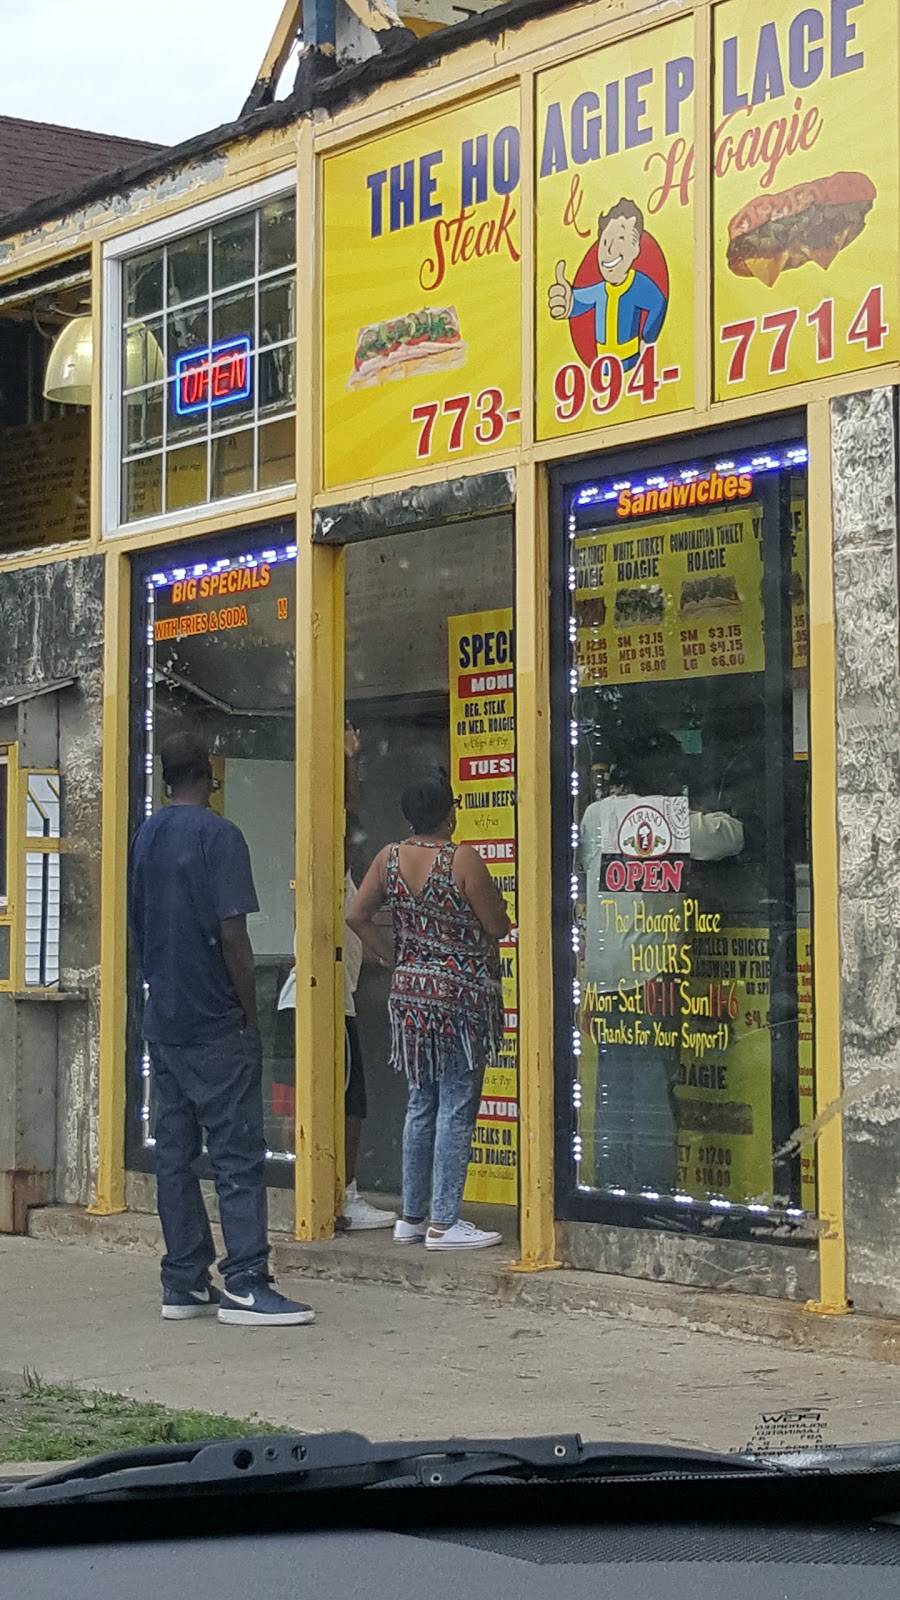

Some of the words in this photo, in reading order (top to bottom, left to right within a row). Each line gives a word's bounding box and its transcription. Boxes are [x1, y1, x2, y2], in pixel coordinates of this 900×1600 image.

[366, 149, 443, 239] THE
[461, 67, 654, 207] HOAGIE
[664, 0, 865, 136] PLACE
[419, 194, 521, 291] Steak
[562, 173, 592, 239] &
[643, 97, 824, 214] Hoagie
[182, 352, 247, 404] OPEN
[410, 387, 521, 459] 773-
[553, 344, 680, 422] 994-
[719, 285, 888, 385] 7714
[616, 472, 753, 518] Sandwiches
[637, 535, 664, 558] TURKEY
[670, 527, 714, 552] COMBINATION
[716, 522, 744, 546] TURKEY
[618, 558, 660, 582] HOAGIE
[687, 548, 726, 573] HOAGIE
[171, 580, 197, 604] BIG
[200, 563, 271, 598] SPECIALS
[155, 618, 178, 640] WITH
[180, 613, 208, 635] FRIES
[209, 611, 217, 632] &
[219, 605, 248, 629] SODA
[680, 629, 699, 643] SM
[708, 625, 742, 639] $3.15
[617, 635, 632, 648] SM
[639, 632, 663, 645] $3.15
[682, 643, 706, 657] MED
[709, 639, 743, 653] $4.15
[619, 649, 637, 661] MED
[639, 645, 665, 659] $4.15
[683, 659, 698, 671] LG
[711, 653, 745, 668] $6.00
[620, 663, 631, 675] LG
[465, 703, 481, 718] REG.
[484, 700, 506, 716] STEAK
[457, 721, 467, 736] OR
[469, 719, 486, 735] MED.
[465, 792, 490, 809] ITALIAN
[628, 811, 663, 827] TURANO
[606, 860, 684, 892] OPEN
[601, 900, 629, 933] The
[633, 900, 680, 944] Hoagie
[683, 898, 721, 933] Place
[631, 943, 693, 975] HOURS
[731, 937, 770, 957] CHICKE
[680, 980, 709, 1016] Sun
[590, 1017, 634, 1045] (Thanks
[635, 1020, 650, 1045] For
[653, 1022, 678, 1047] Your
[681, 1022, 729, 1057] Support)
[678, 1063, 728, 1090] OAGIE
[478, 1100, 518, 1117] ATUR
[503, 1129, 512, 1146] OR
[472, 1147, 483, 1164] ED
[485, 1149, 517, 1167] HOAGIES
